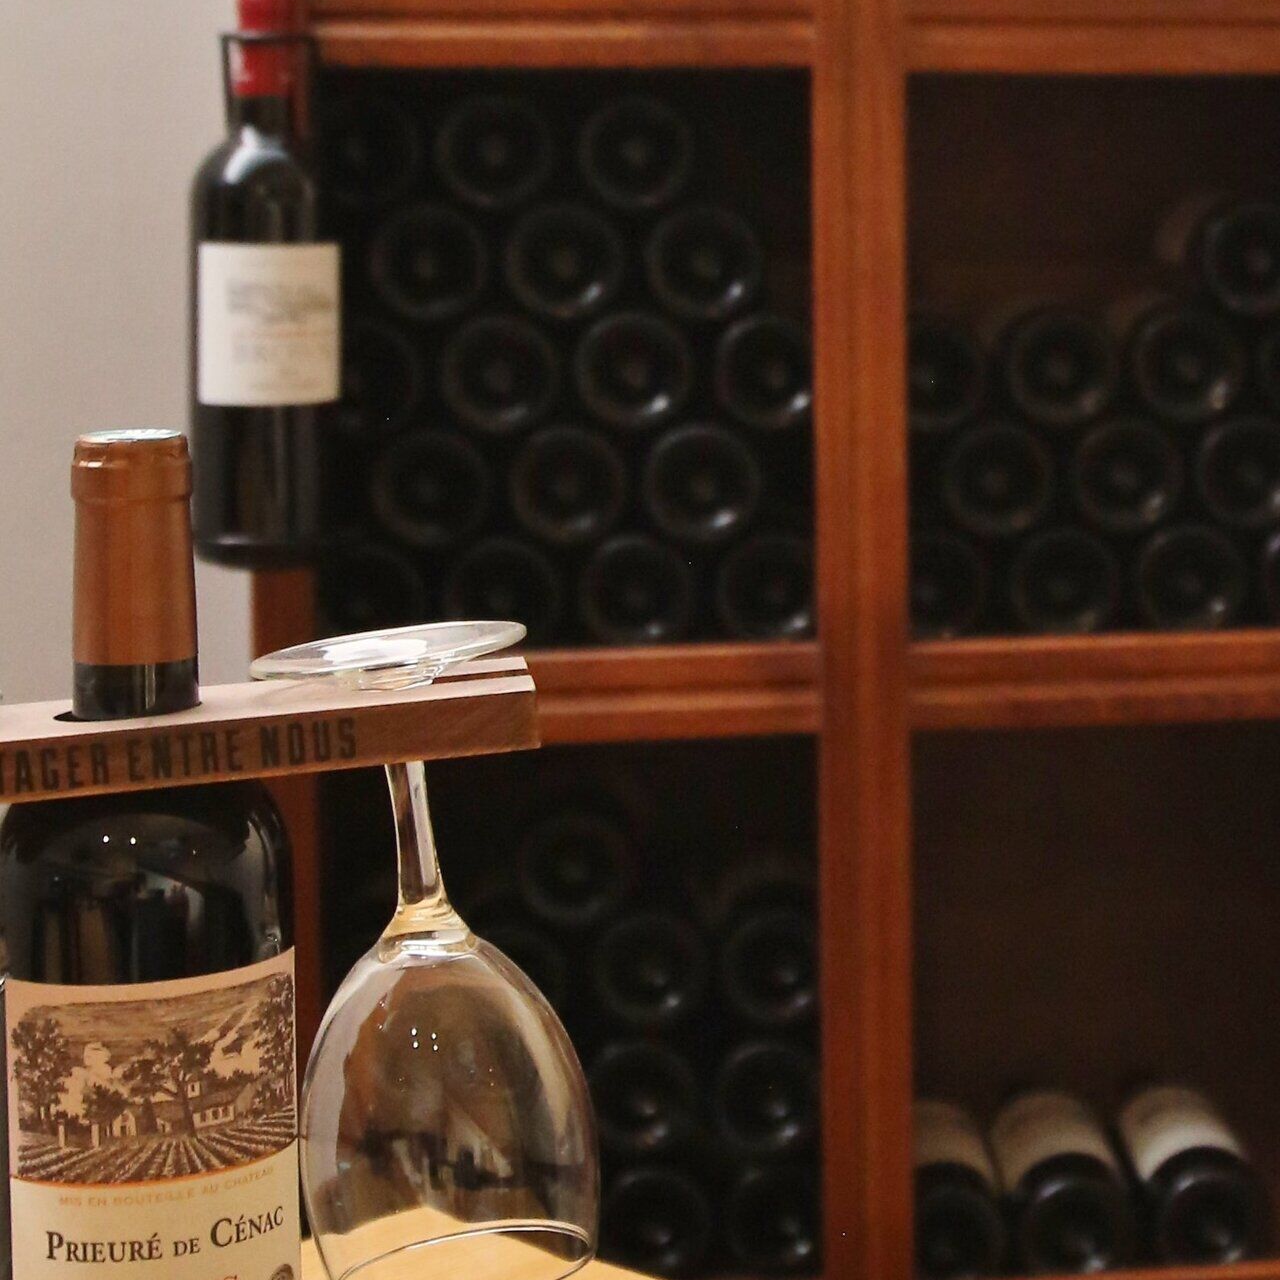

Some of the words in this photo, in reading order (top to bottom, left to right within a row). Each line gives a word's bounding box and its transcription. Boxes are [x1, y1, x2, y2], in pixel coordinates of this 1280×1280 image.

[127, 729, 243, 779] ENTRE
[259, 717, 358, 767] NOUS
[88, 1195, 107, 1207] EN
[45, 1231, 163, 1264] PRIEURÉ
[209, 1205, 285, 1248] CÉNAC
